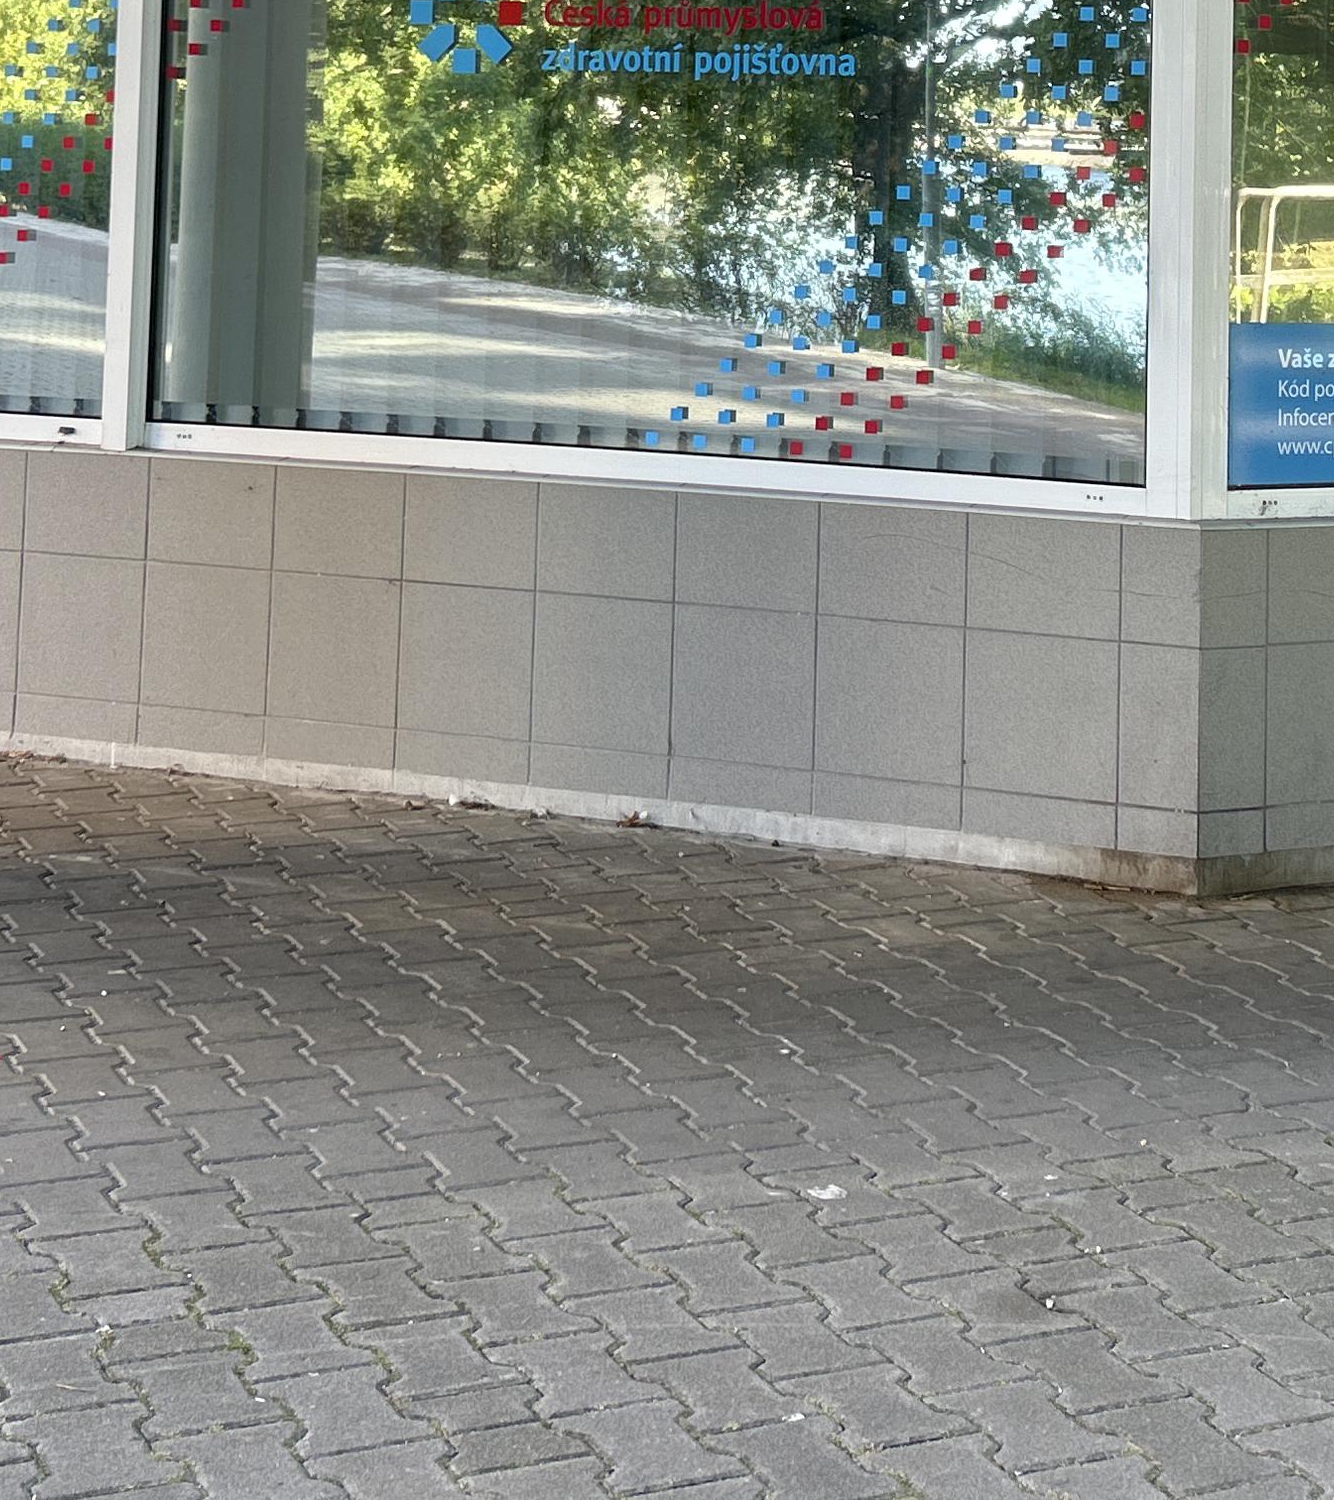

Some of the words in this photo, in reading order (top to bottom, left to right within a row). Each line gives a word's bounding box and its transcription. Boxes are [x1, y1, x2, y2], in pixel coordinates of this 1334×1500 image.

[540, 40, 684, 73] zdravotní
[694, 42, 857, 82] pojišťovna
[1278, 348, 1324, 369] Vaše
[1278, 379, 1310, 398] Kód
